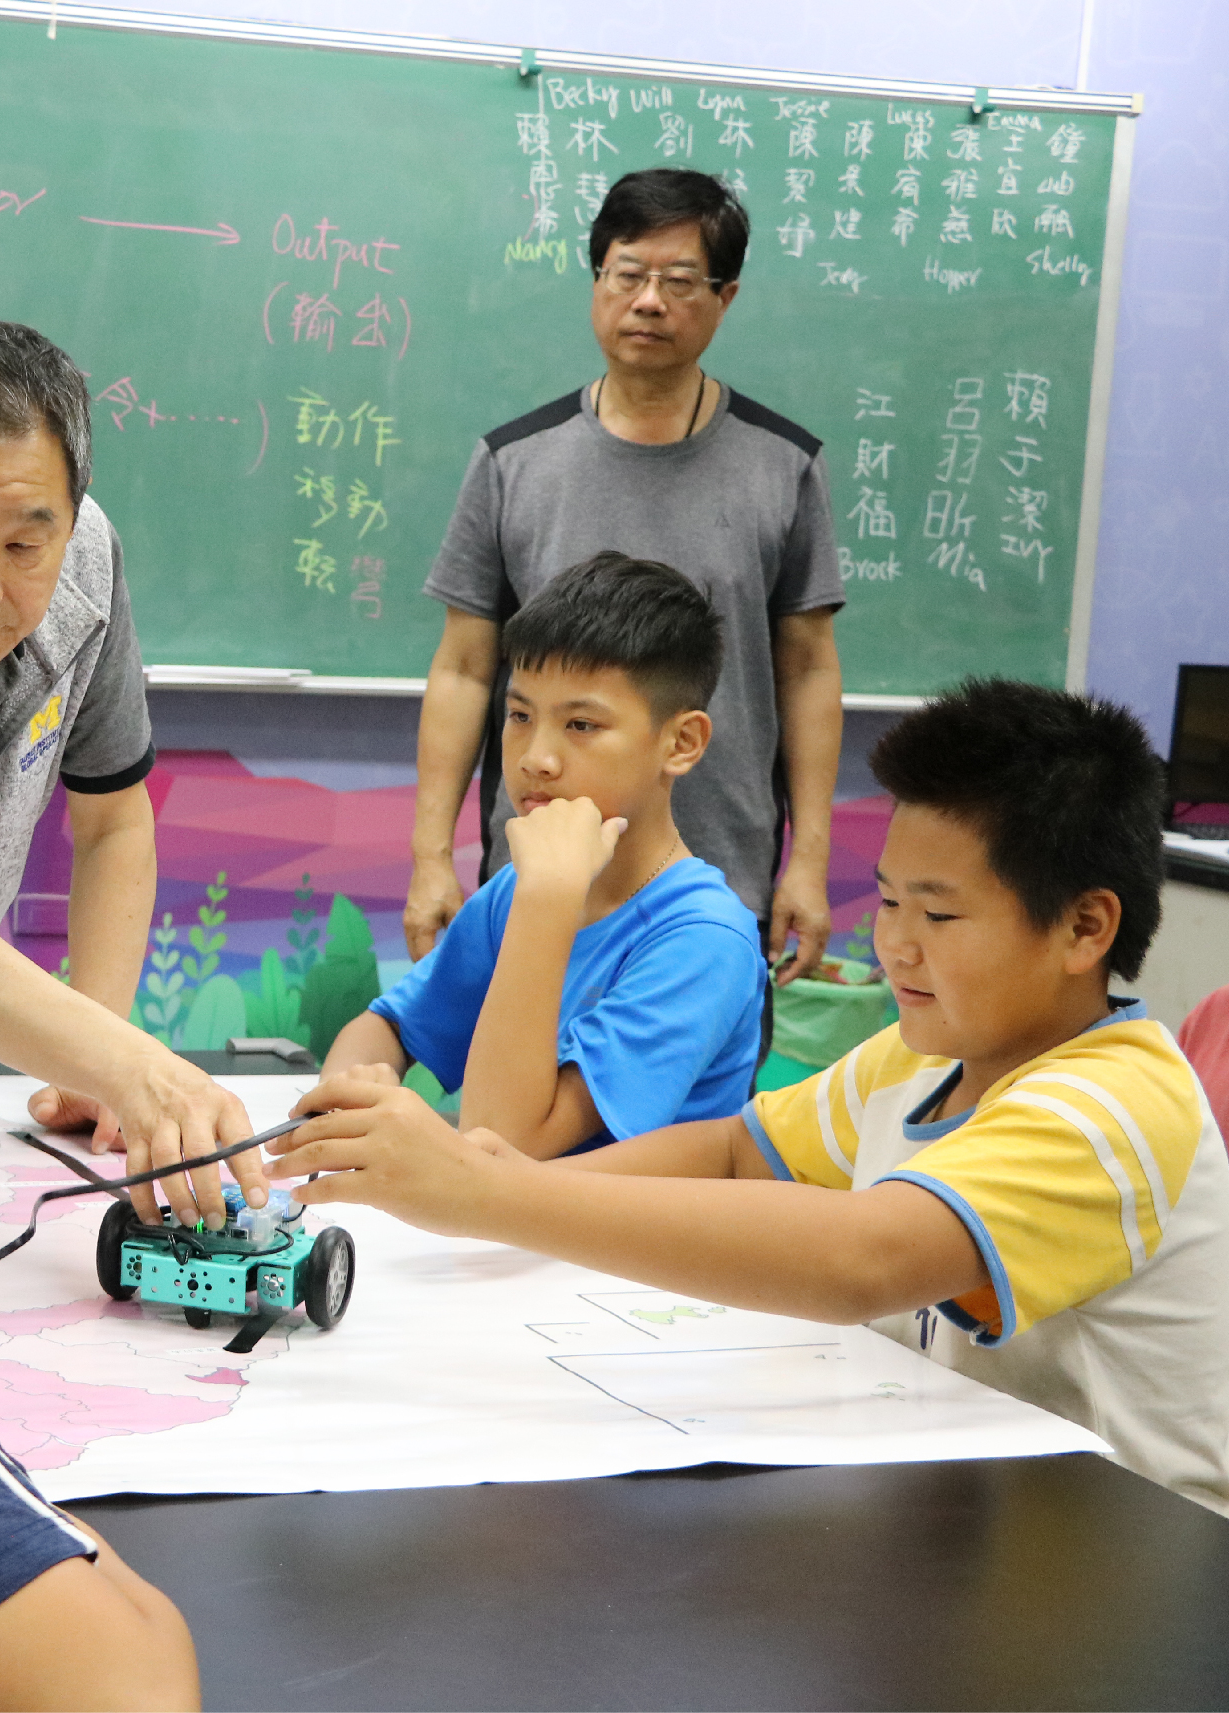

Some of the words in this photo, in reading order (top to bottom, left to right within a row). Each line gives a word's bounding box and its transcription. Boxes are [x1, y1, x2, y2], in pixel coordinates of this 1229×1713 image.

[546, 77, 620, 119] Becky
[629, 85, 673, 113] Will
[272, 213, 401, 290] Output
[286, 385, 404, 468] 動作
